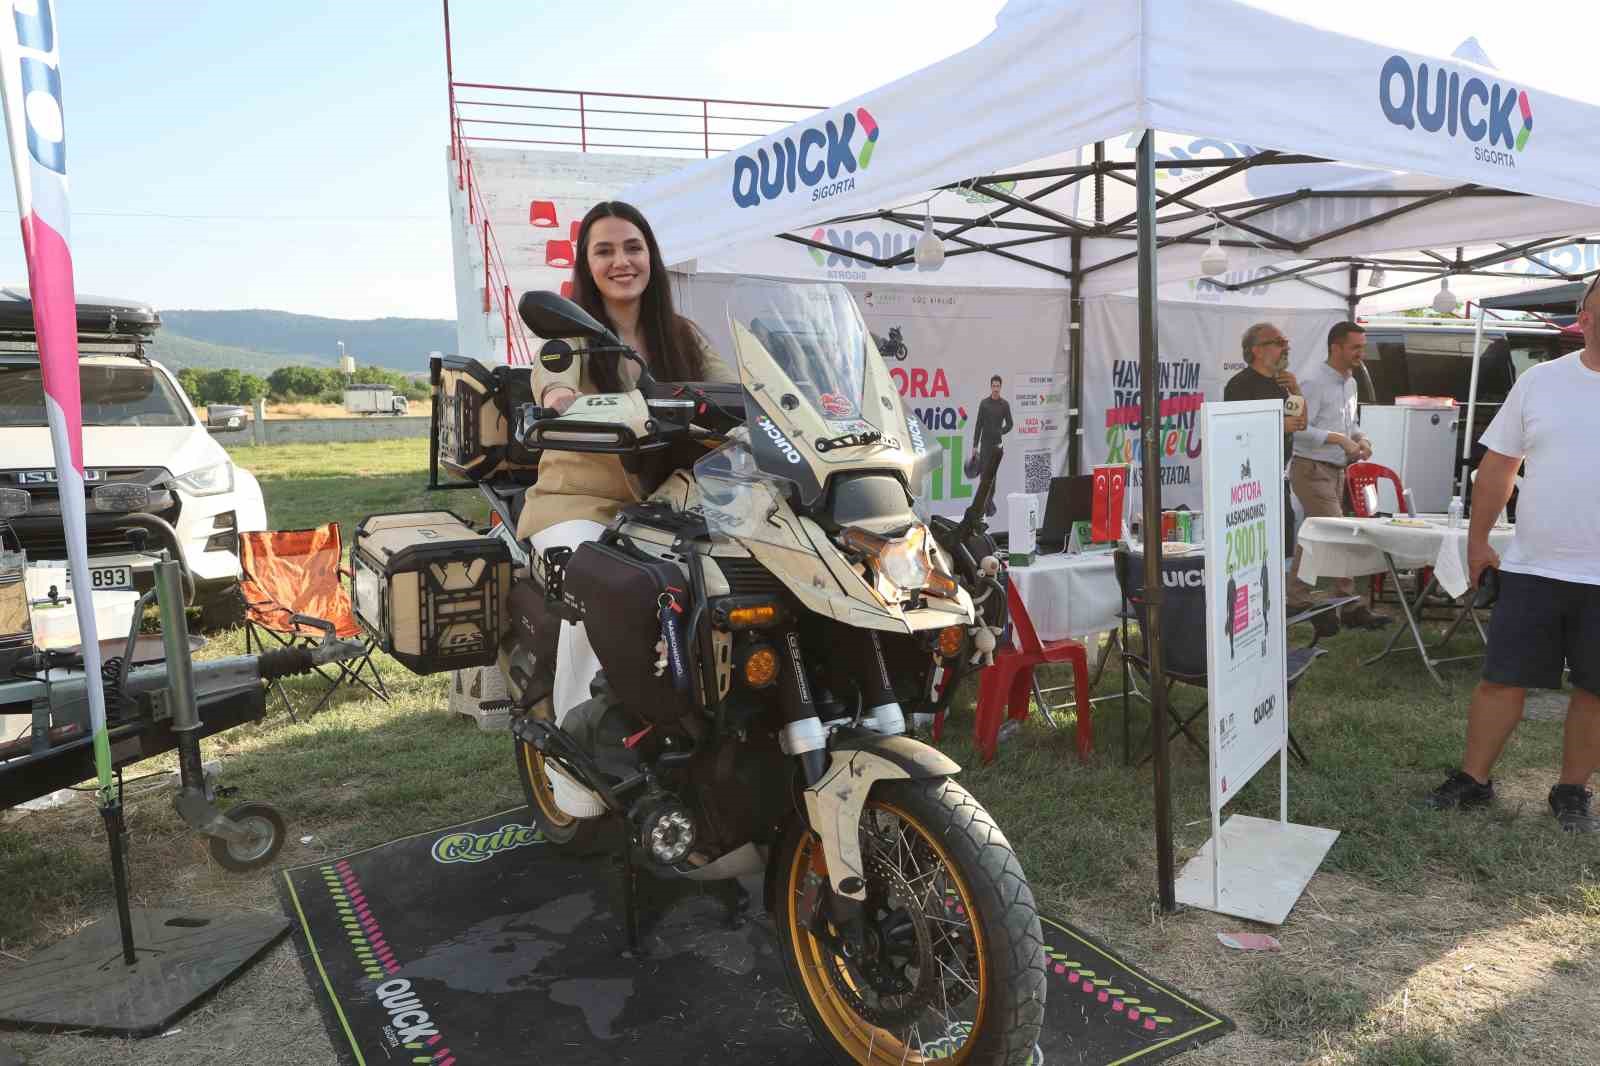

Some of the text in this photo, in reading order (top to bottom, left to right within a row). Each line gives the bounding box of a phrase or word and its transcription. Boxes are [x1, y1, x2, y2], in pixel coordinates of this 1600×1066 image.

[1379, 55, 1518, 150] QUICK
[732, 112, 857, 209] QUICK
[889, 367, 950, 398] ORA
[1172, 358, 1200, 389] TÜM
[758, 419, 801, 465] QUICK
[19, 471, 100, 484] ISUU
[1231, 481, 1262, 504] MOTORA
[92, 568, 126, 587] 893
[1161, 569, 1206, 588] UIC
[376, 978, 439, 1043] QUICK
